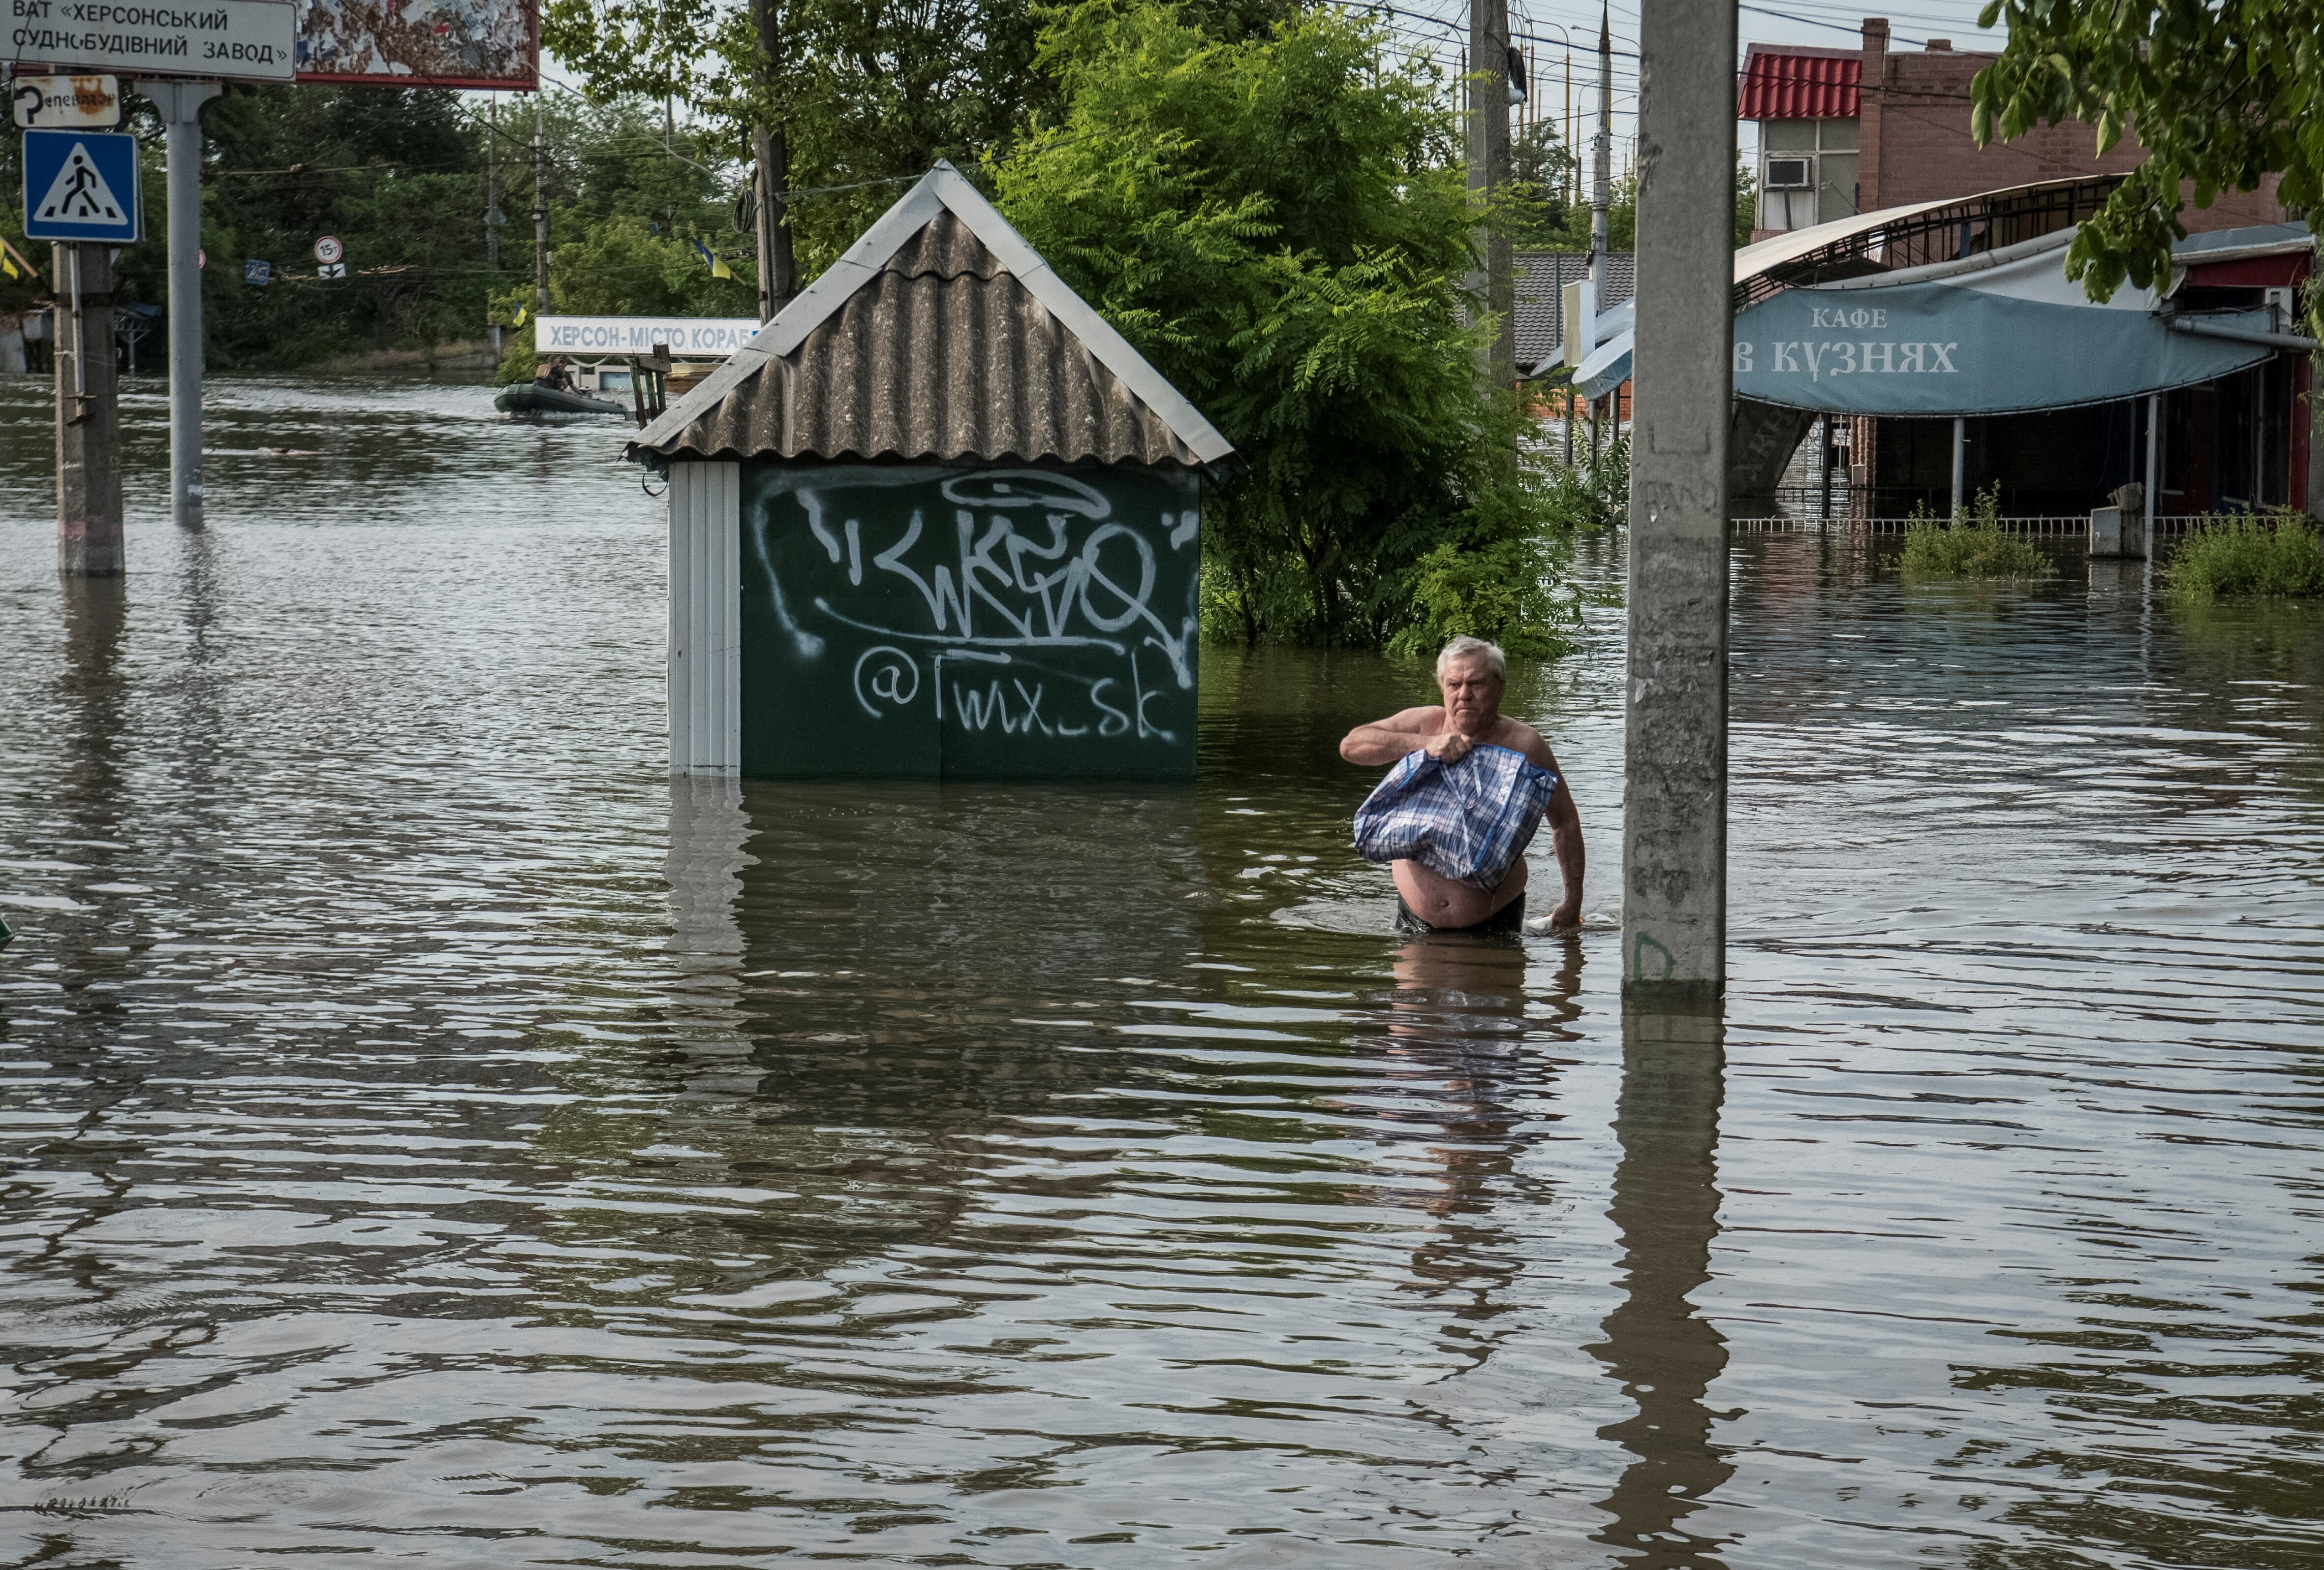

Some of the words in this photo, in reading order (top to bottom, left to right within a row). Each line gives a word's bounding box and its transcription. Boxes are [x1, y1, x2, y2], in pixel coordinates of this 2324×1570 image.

[13, 0, 52, 18] ВАТ
[61, 4, 228, 31] «ХЕРСОНСЬКИЙ
[203, 41, 287, 65] ЗАВОД»
[1811, 308, 1888, 328] КАФЕ
[691, 328, 752, 348] КОРАБ
[1771, 342, 1959, 382] КУЗНЯХ
